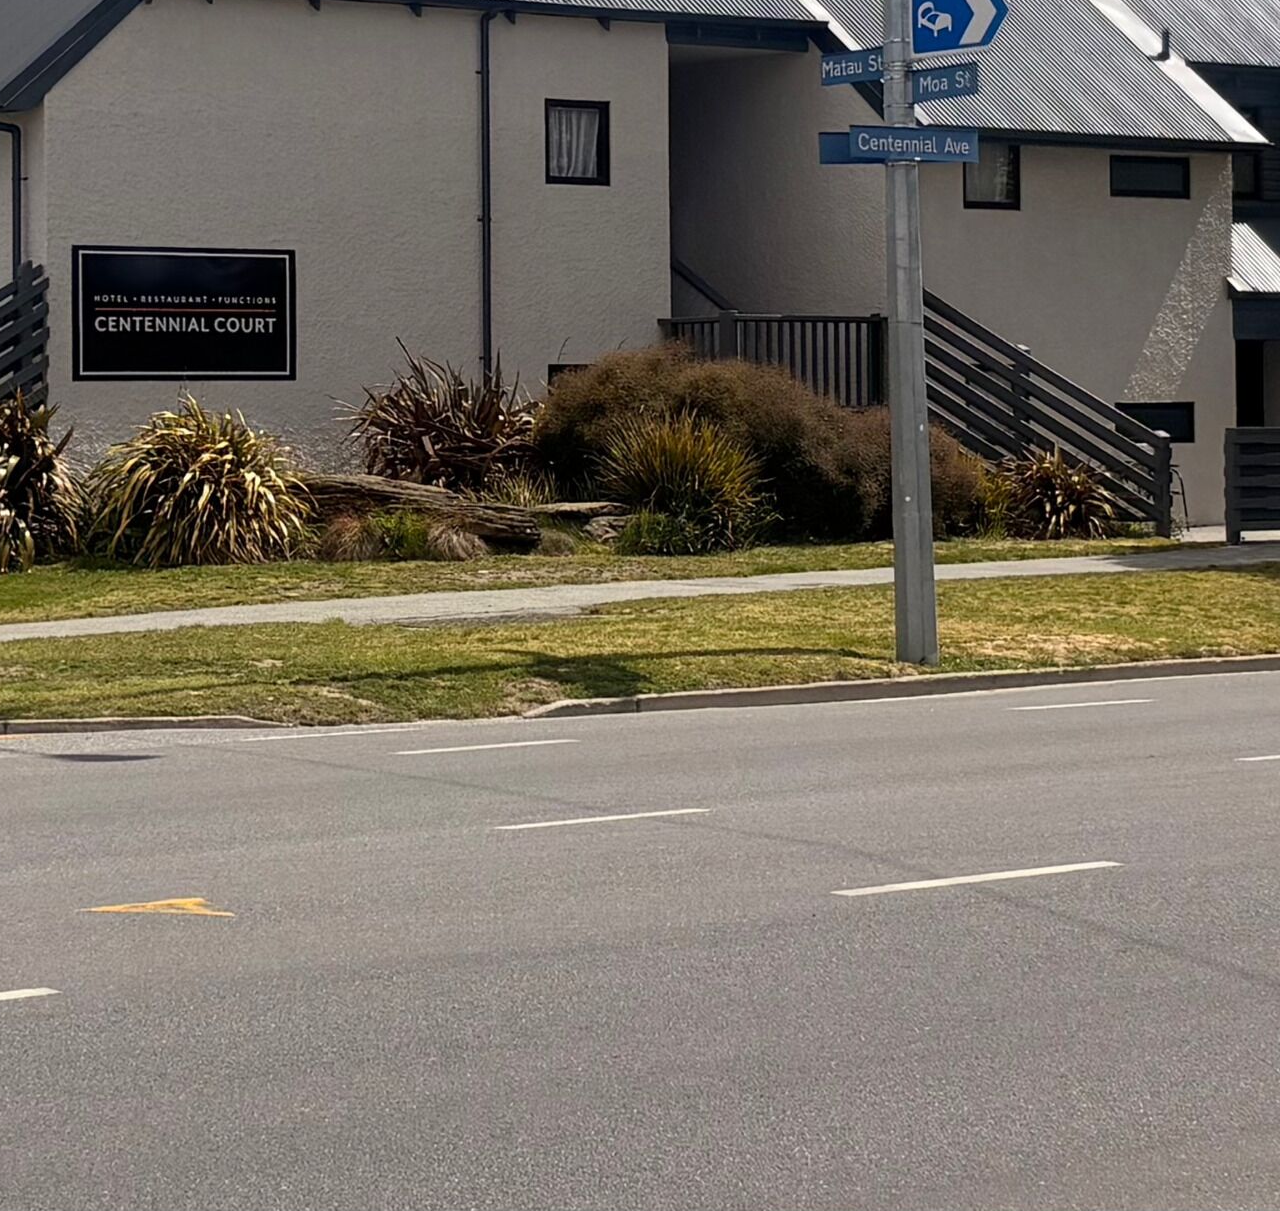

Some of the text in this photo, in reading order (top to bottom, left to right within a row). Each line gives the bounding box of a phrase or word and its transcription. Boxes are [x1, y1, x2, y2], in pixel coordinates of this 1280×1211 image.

[822, 56, 883, 78] Matau St
[920, 71, 971, 93] Moa St
[858, 133, 970, 154] Centennial Ave
[94, 295, 276, 304] HOTEL RESTAURANT FUNCTIONS
[94, 316, 277, 333] CENTENNIAL COURT
